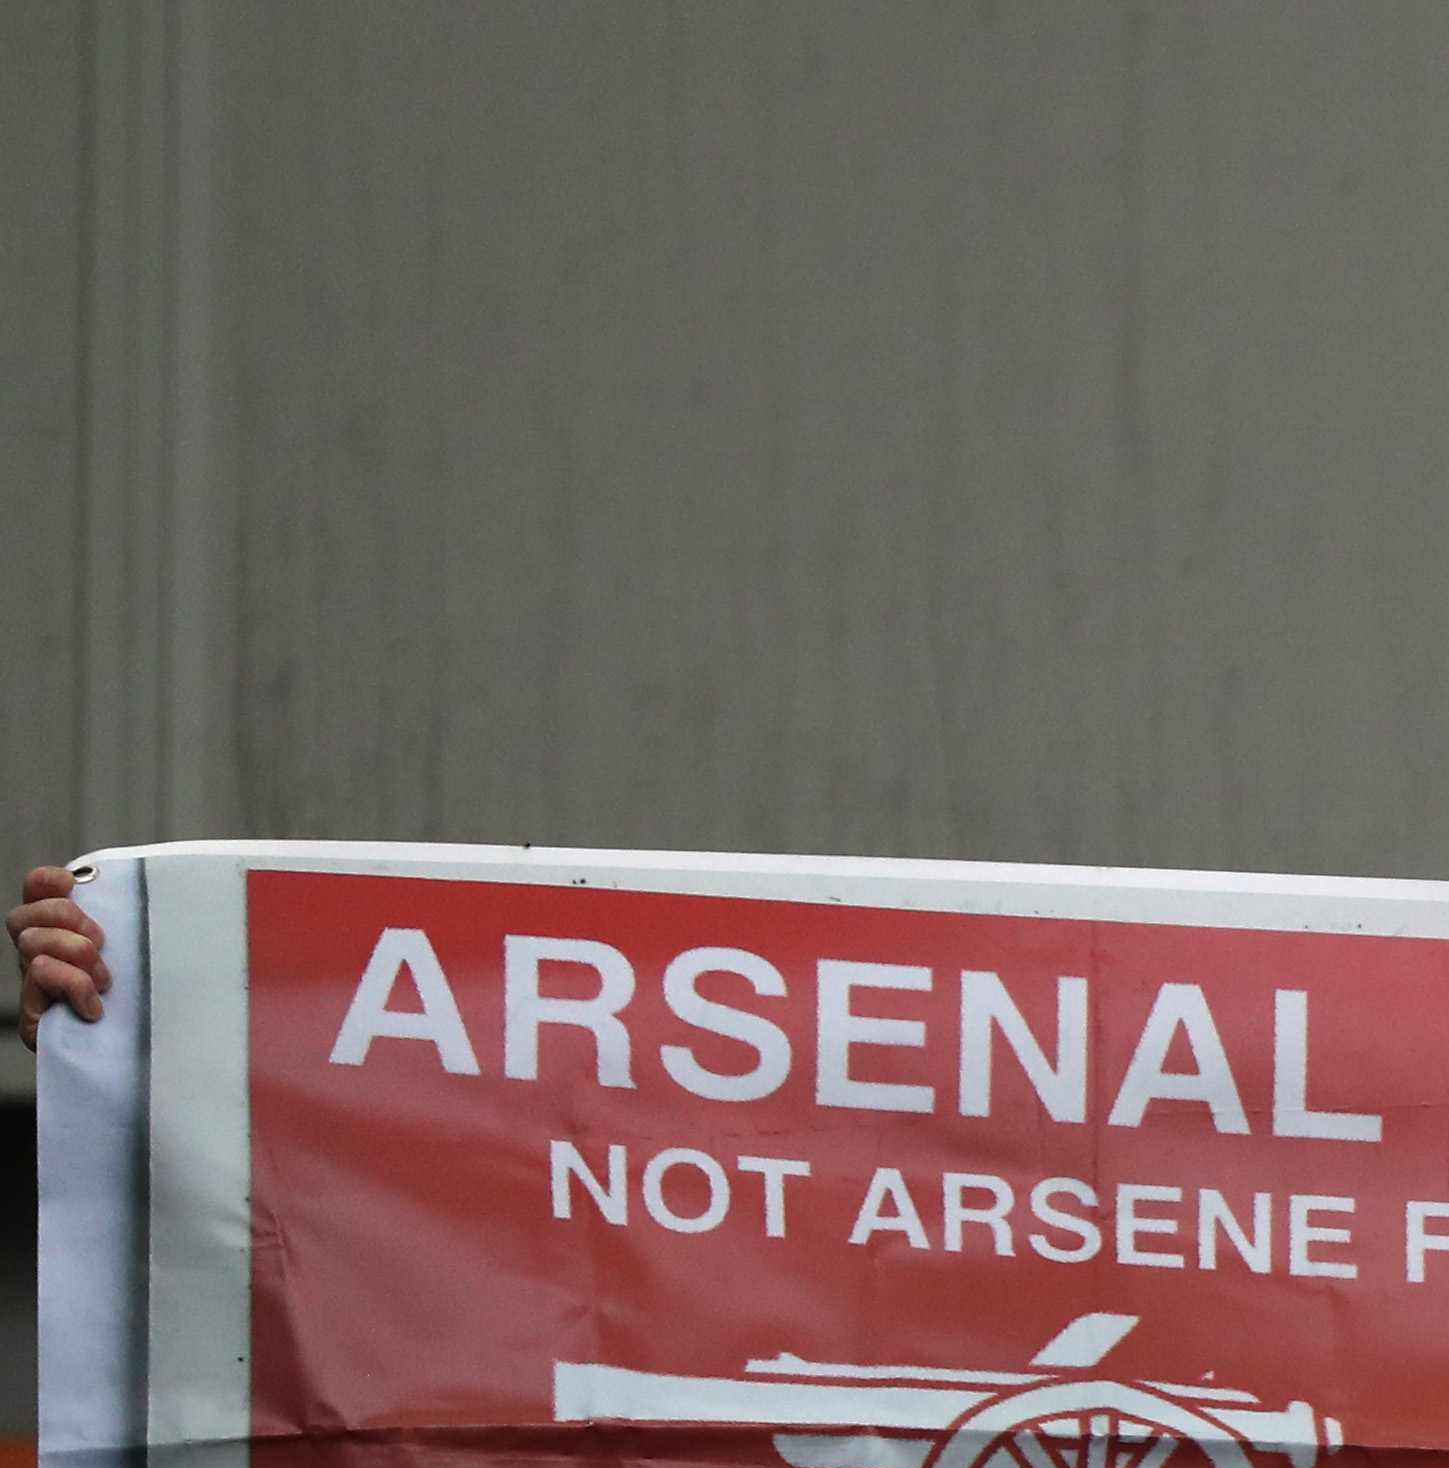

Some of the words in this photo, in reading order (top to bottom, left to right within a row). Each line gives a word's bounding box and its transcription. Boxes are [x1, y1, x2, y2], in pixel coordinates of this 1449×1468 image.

[330, 929, 1383, 1143] ARSENAL
[551, 1142, 811, 1239] NOT
[850, 1168, 1359, 1280] ARSENE
